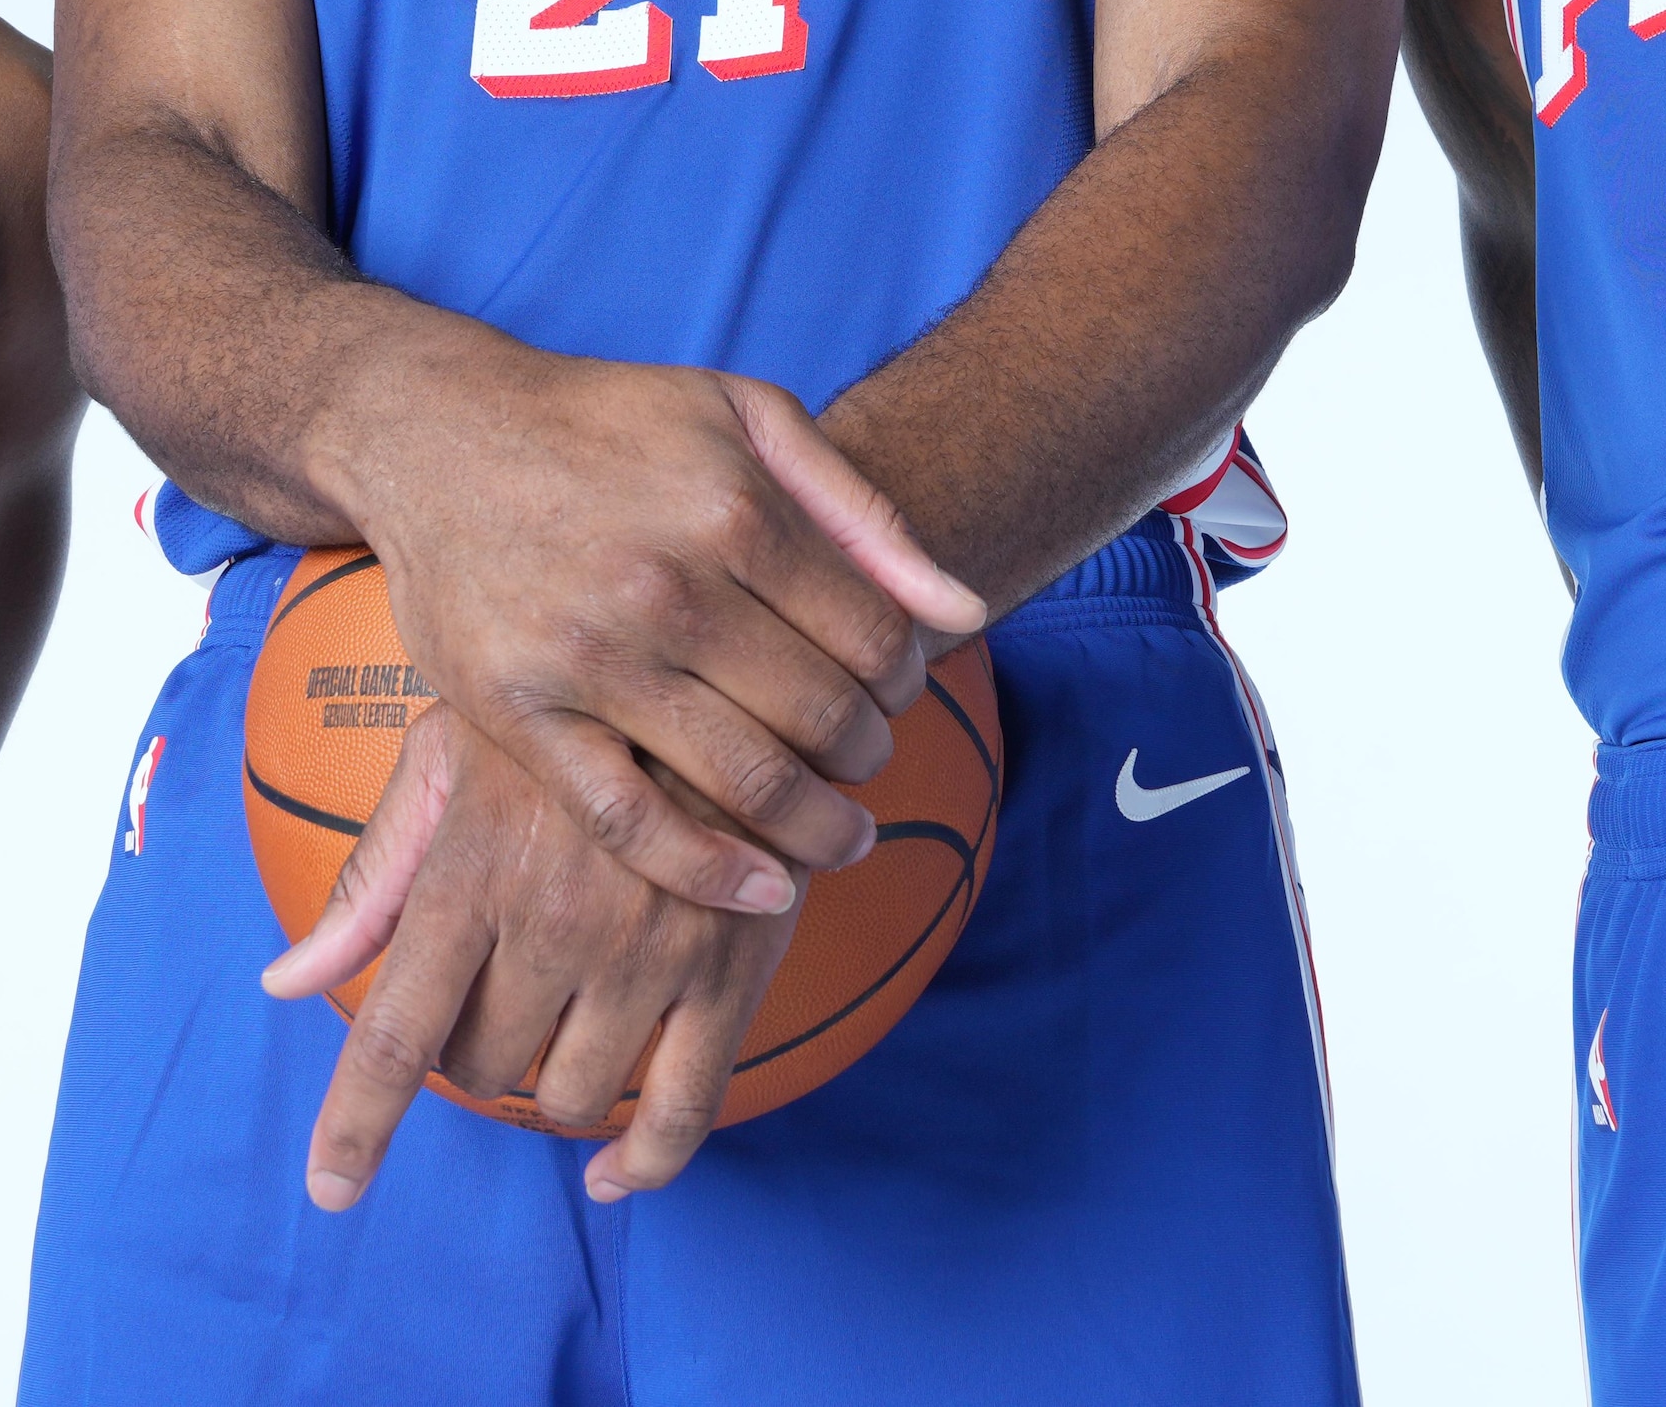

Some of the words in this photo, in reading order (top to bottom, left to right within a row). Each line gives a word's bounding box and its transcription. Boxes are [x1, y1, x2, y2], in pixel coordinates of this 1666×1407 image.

[307, 665, 357, 698] OFFICIAL
[359, 664, 402, 697] GAME
[324, 703, 362, 728] GENUINE
[363, 703, 407, 728] LEATHER
